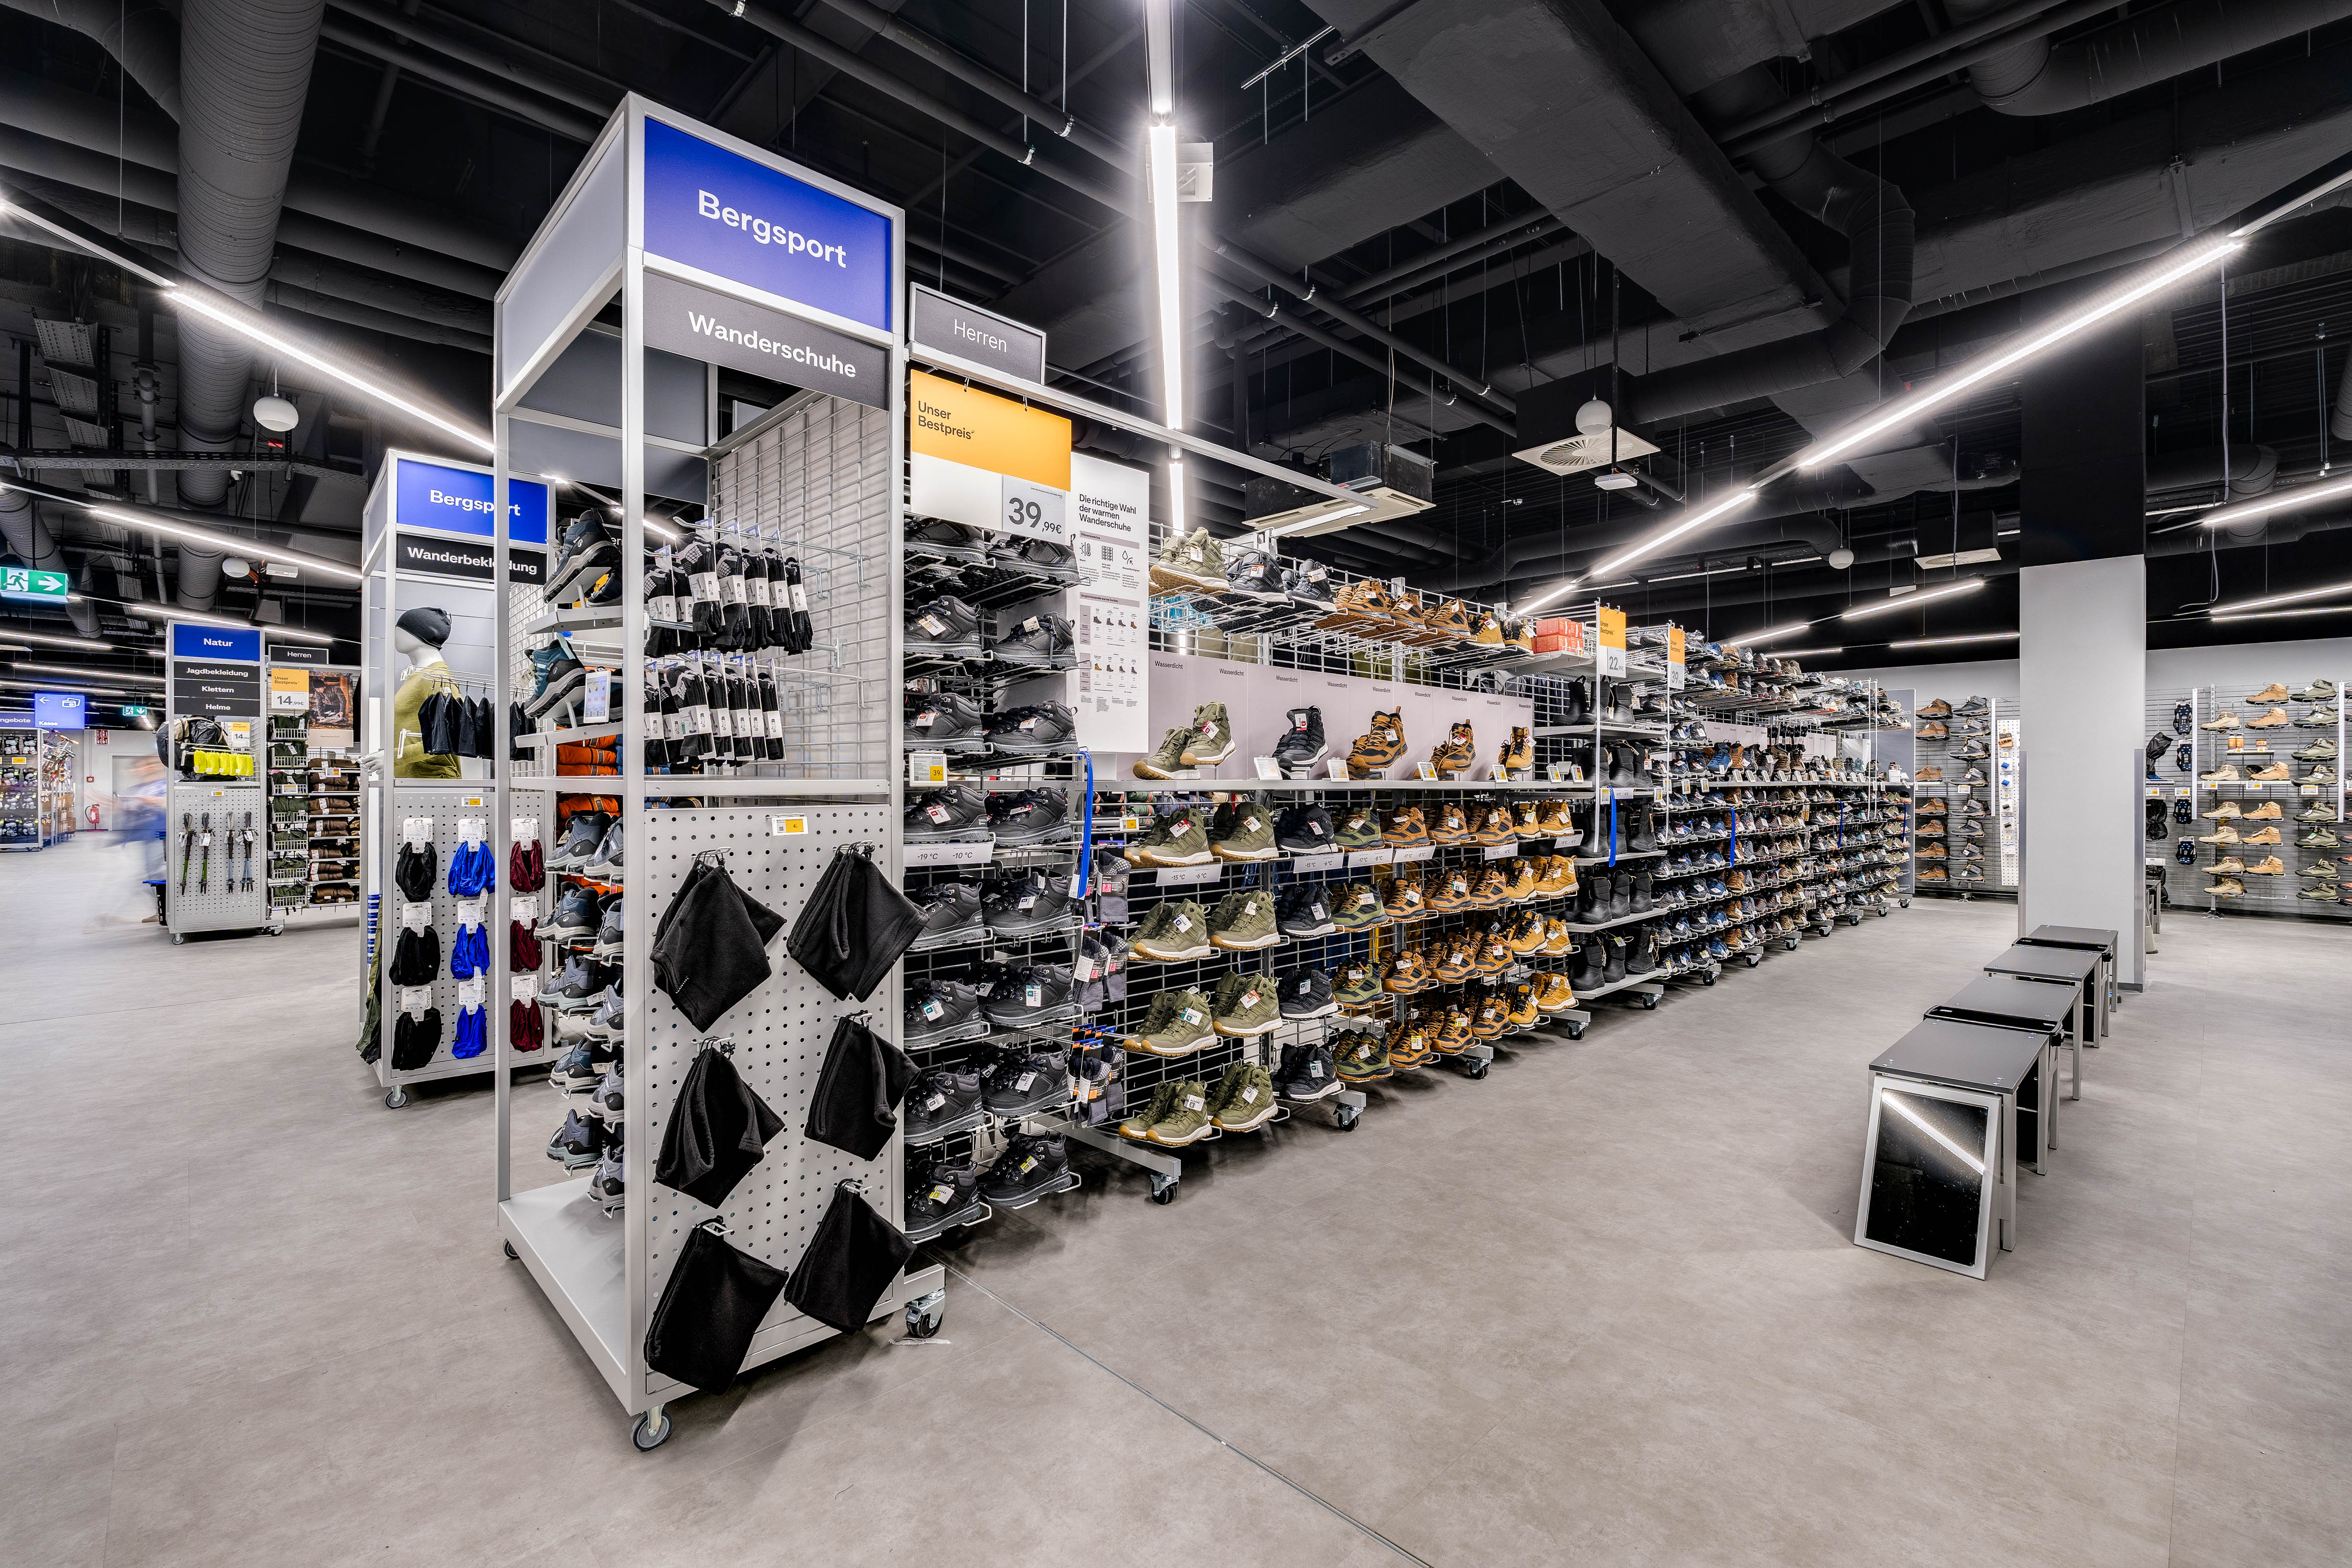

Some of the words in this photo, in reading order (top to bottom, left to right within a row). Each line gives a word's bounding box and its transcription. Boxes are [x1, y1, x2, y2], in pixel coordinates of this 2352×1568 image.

[698, 189, 847, 269] Bergsport
[688, 311, 856, 377] Wanderschuhe
[954, 319, 1007, 353] Herren
[918, 401, 951, 420] Unser
[430, 490, 521, 516] Bergsprt
[1079, 494, 1091, 504] Die
[1092, 498, 1118, 511] richtige
[1119, 503, 1136, 514] Wahl
[1079, 504, 1091, 513] der
[1092, 508, 1120, 520] warmen
[1079, 513, 1131, 532] Wanderschuhe
[407, 547, 538, 575] Wanderbekldung
[203, 638, 233, 647] Natur
[186, 667, 248, 677] Jagdbekleidung
[1155, 660, 1183, 669] Wasserdicht
[1220, 668, 1244, 676] Wasserdicht
